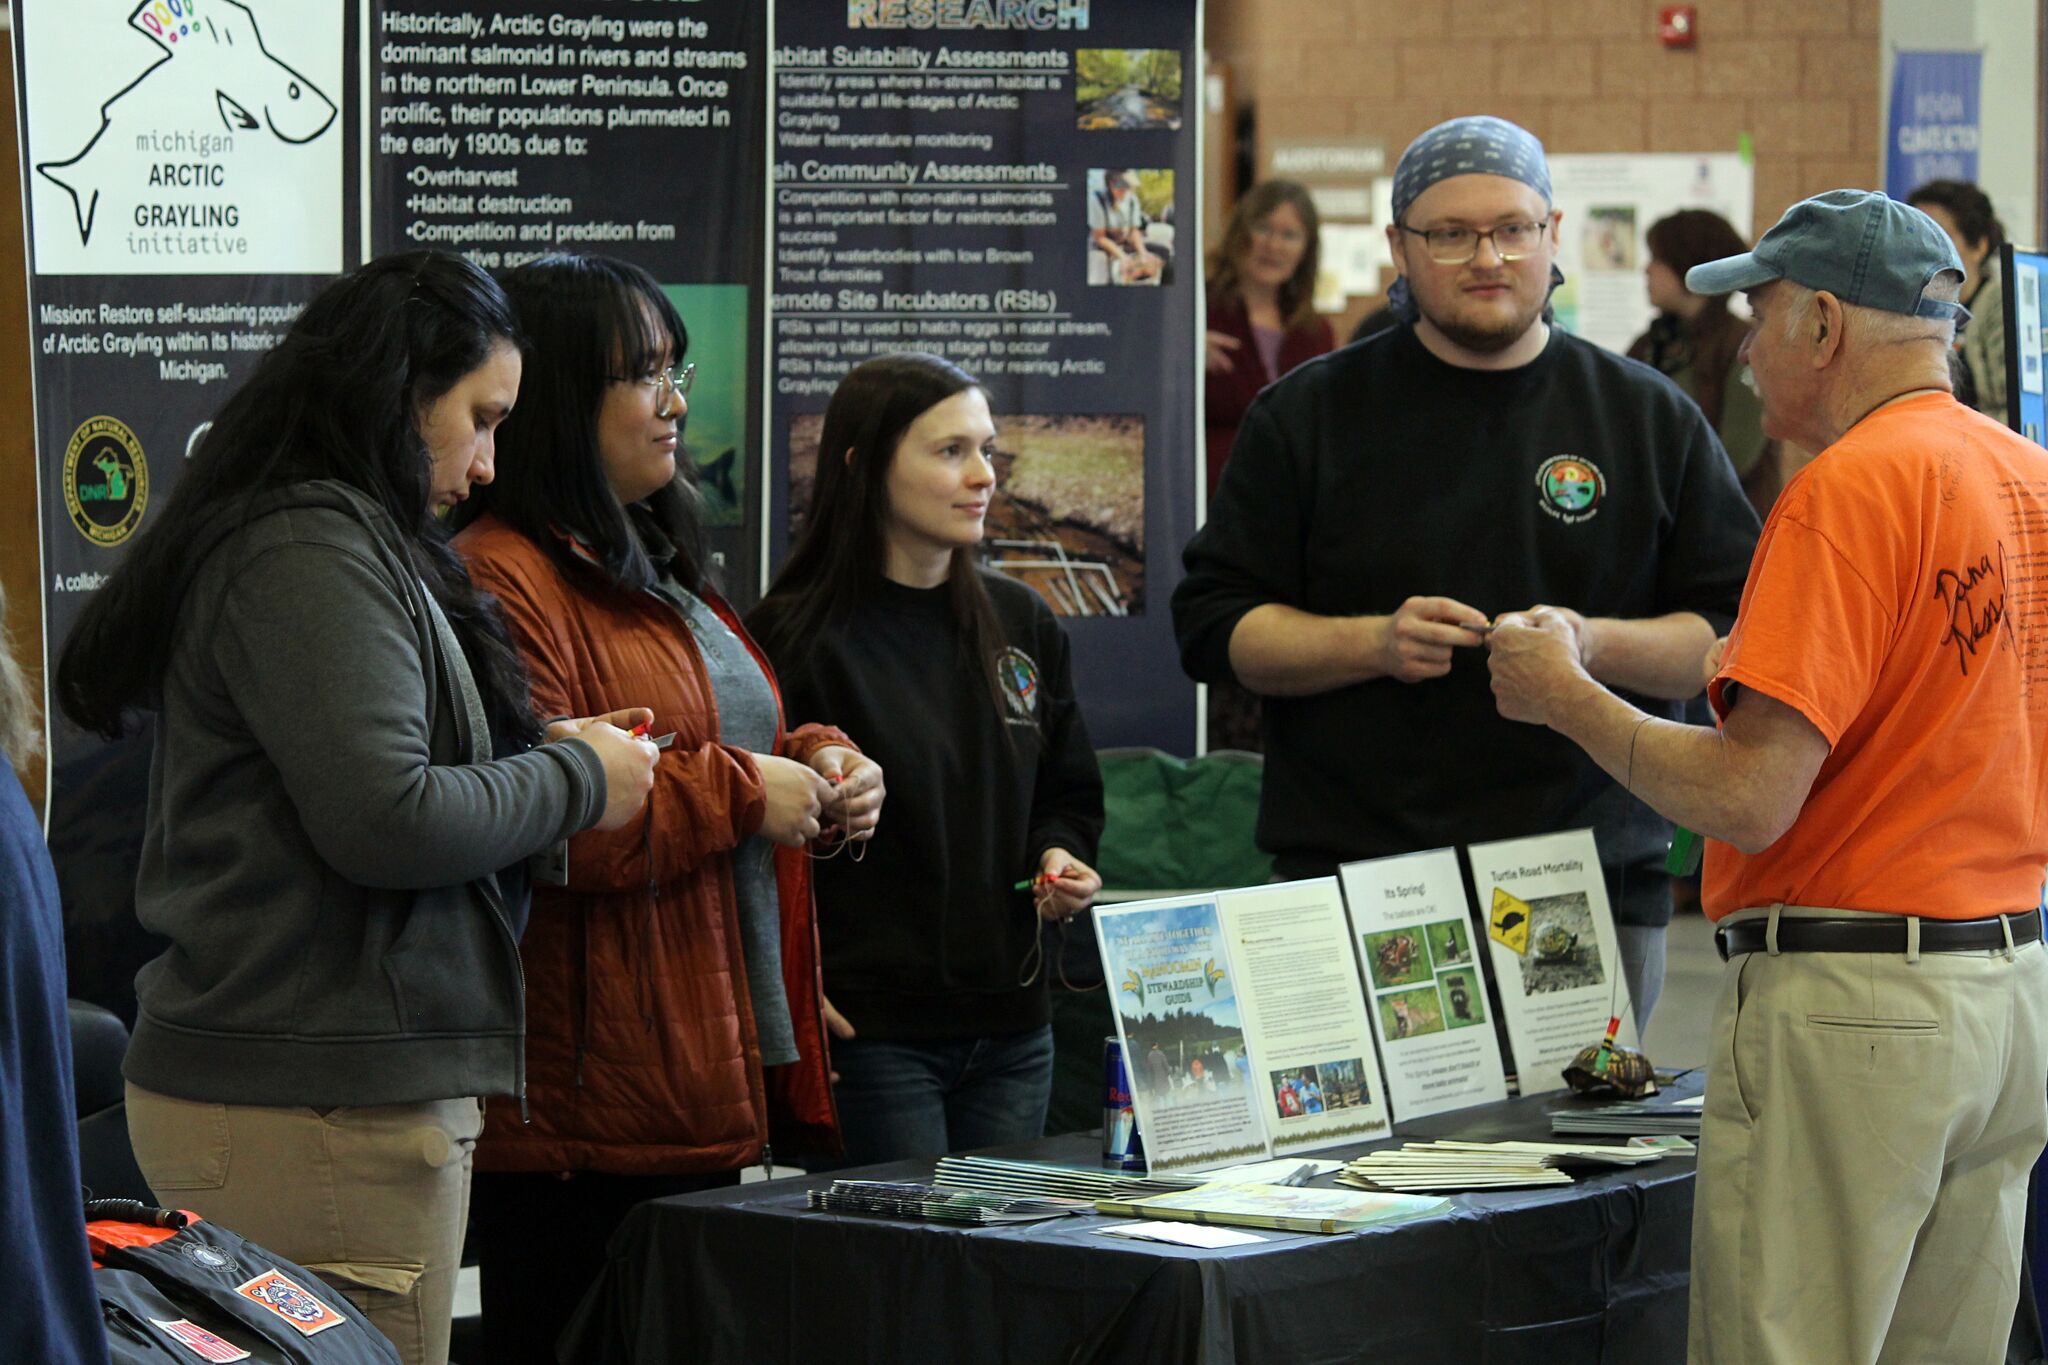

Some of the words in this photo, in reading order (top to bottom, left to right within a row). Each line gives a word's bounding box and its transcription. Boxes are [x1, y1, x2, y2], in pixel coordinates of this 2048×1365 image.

[847, 0, 1090, 30] RESEARCH
[381, 11, 485, 40] Historically,
[490, 13, 543, 36] Arctic
[549, 14, 624, 42] Grayling
[629, 18, 674, 38] were
[678, 16, 708, 38] the
[381, 43, 467, 64] dominant
[471, 44, 554, 65] salmonid
[558, 45, 575, 66] in
[580, 45, 631, 67] rivers
[635, 46, 669, 67] and
[673, 48, 747, 69] streams
[833, 45, 929, 71] Suitability
[935, 48, 1068, 67] Assessments
[381, 73, 396, 93] in
[401, 73, 430, 94] the
[436, 74, 516, 95] northern
[521, 74, 578, 96] Lower
[582, 75, 674, 97] Peninsula.
[678, 77, 728, 98] Once
[996, 75, 1046, 89] habitat
[1048, 75, 1062, 90] is
[838, 92, 859, 108] for
[861, 93, 879, 108] all
[957, 93, 974, 109] of
[975, 93, 1020, 109] Arctic
[381, 104, 447, 127] prolific,
[451, 104, 493, 124] their
[498, 105, 604, 128] populations
[607, 105, 708, 129] plummeted
[712, 105, 730, 126] in
[779, 111, 840, 131] Grayling
[136, 130, 234, 157] michigan
[381, 134, 408, 154] the
[412, 136, 459, 159] early
[465, 135, 521, 156] 1900s
[525, 134, 561, 156] due
[565, 135, 588, 156] to:
[779, 132, 821, 148] Water
[824, 132, 913, 150] temperature
[914, 132, 993, 151] monitoring
[149, 164, 225, 187] ARCTIC
[412, 166, 518, 187] Overharvest
[802, 160, 918, 185] Community
[923, 161, 1057, 182] Assessments
[412, 195, 473, 214] Habitat
[478, 195, 572, 215] destruction
[779, 190, 867, 207] Competition
[869, 190, 900, 205] with
[980, 191, 1054, 206] salmonids
[134, 204, 240, 228] GRAYLING
[779, 210, 791, 224] is
[794, 211, 814, 224] an
[815, 210, 886, 227] important
[887, 209, 929, 225] factor
[932, 209, 953, 225] for
[956, 209, 1058, 225] reintroduction
[127, 232, 248, 254] initiative
[411, 221, 516, 244] Competition
[519, 222, 552, 241] and
[556, 222, 633, 244] predation
[636, 221, 676, 241] from
[924, 248, 955, 264] with
[957, 248, 983, 264] low
[986, 247, 1034, 264] Brown
[779, 266, 816, 282] Trout
[818, 267, 884, 282] densities
[838, 289, 878, 311] Site
[882, 289, 989, 311] Incubators
[995, 291, 1057, 312] (RSIs)
[40, 304, 96, 325] Mission:
[99, 304, 155, 325] Restore
[157, 303, 256, 328] self-sustaining
[814, 320, 839, 335] will
[841, 320, 860, 335] be
[863, 320, 900, 335] used
[902, 320, 919, 335] to
[920, 320, 961, 336] hatch
[964, 322, 1000, 338] eggs
[1002, 320, 1018, 336] in
[1019, 320, 1056, 336] natal
[42, 333, 55, 354] of
[57, 334, 100, 354] Arctic
[103, 332, 163, 358] Grayling
[165, 331, 209, 351] within
[211, 331, 229, 352] its
[231, 331, 275, 351] historic
[840, 340, 870, 354] vital
[947, 340, 987, 358] stage
[989, 340, 1005, 354] to
[1007, 341, 1049, 355] occur
[160, 359, 228, 385] Michigan.
[814, 358, 850, 374] have
[984, 359, 1005, 374] for
[1007, 360, 1060, 378] rearing
[1061, 359, 1106, 374] Arctic
[54, 573, 66, 592] A
[1491, 869, 1518, 881] Turtle
[1519, 866, 1542, 879] Road
[1147, 977, 1204, 994] STEWARDSHIP
